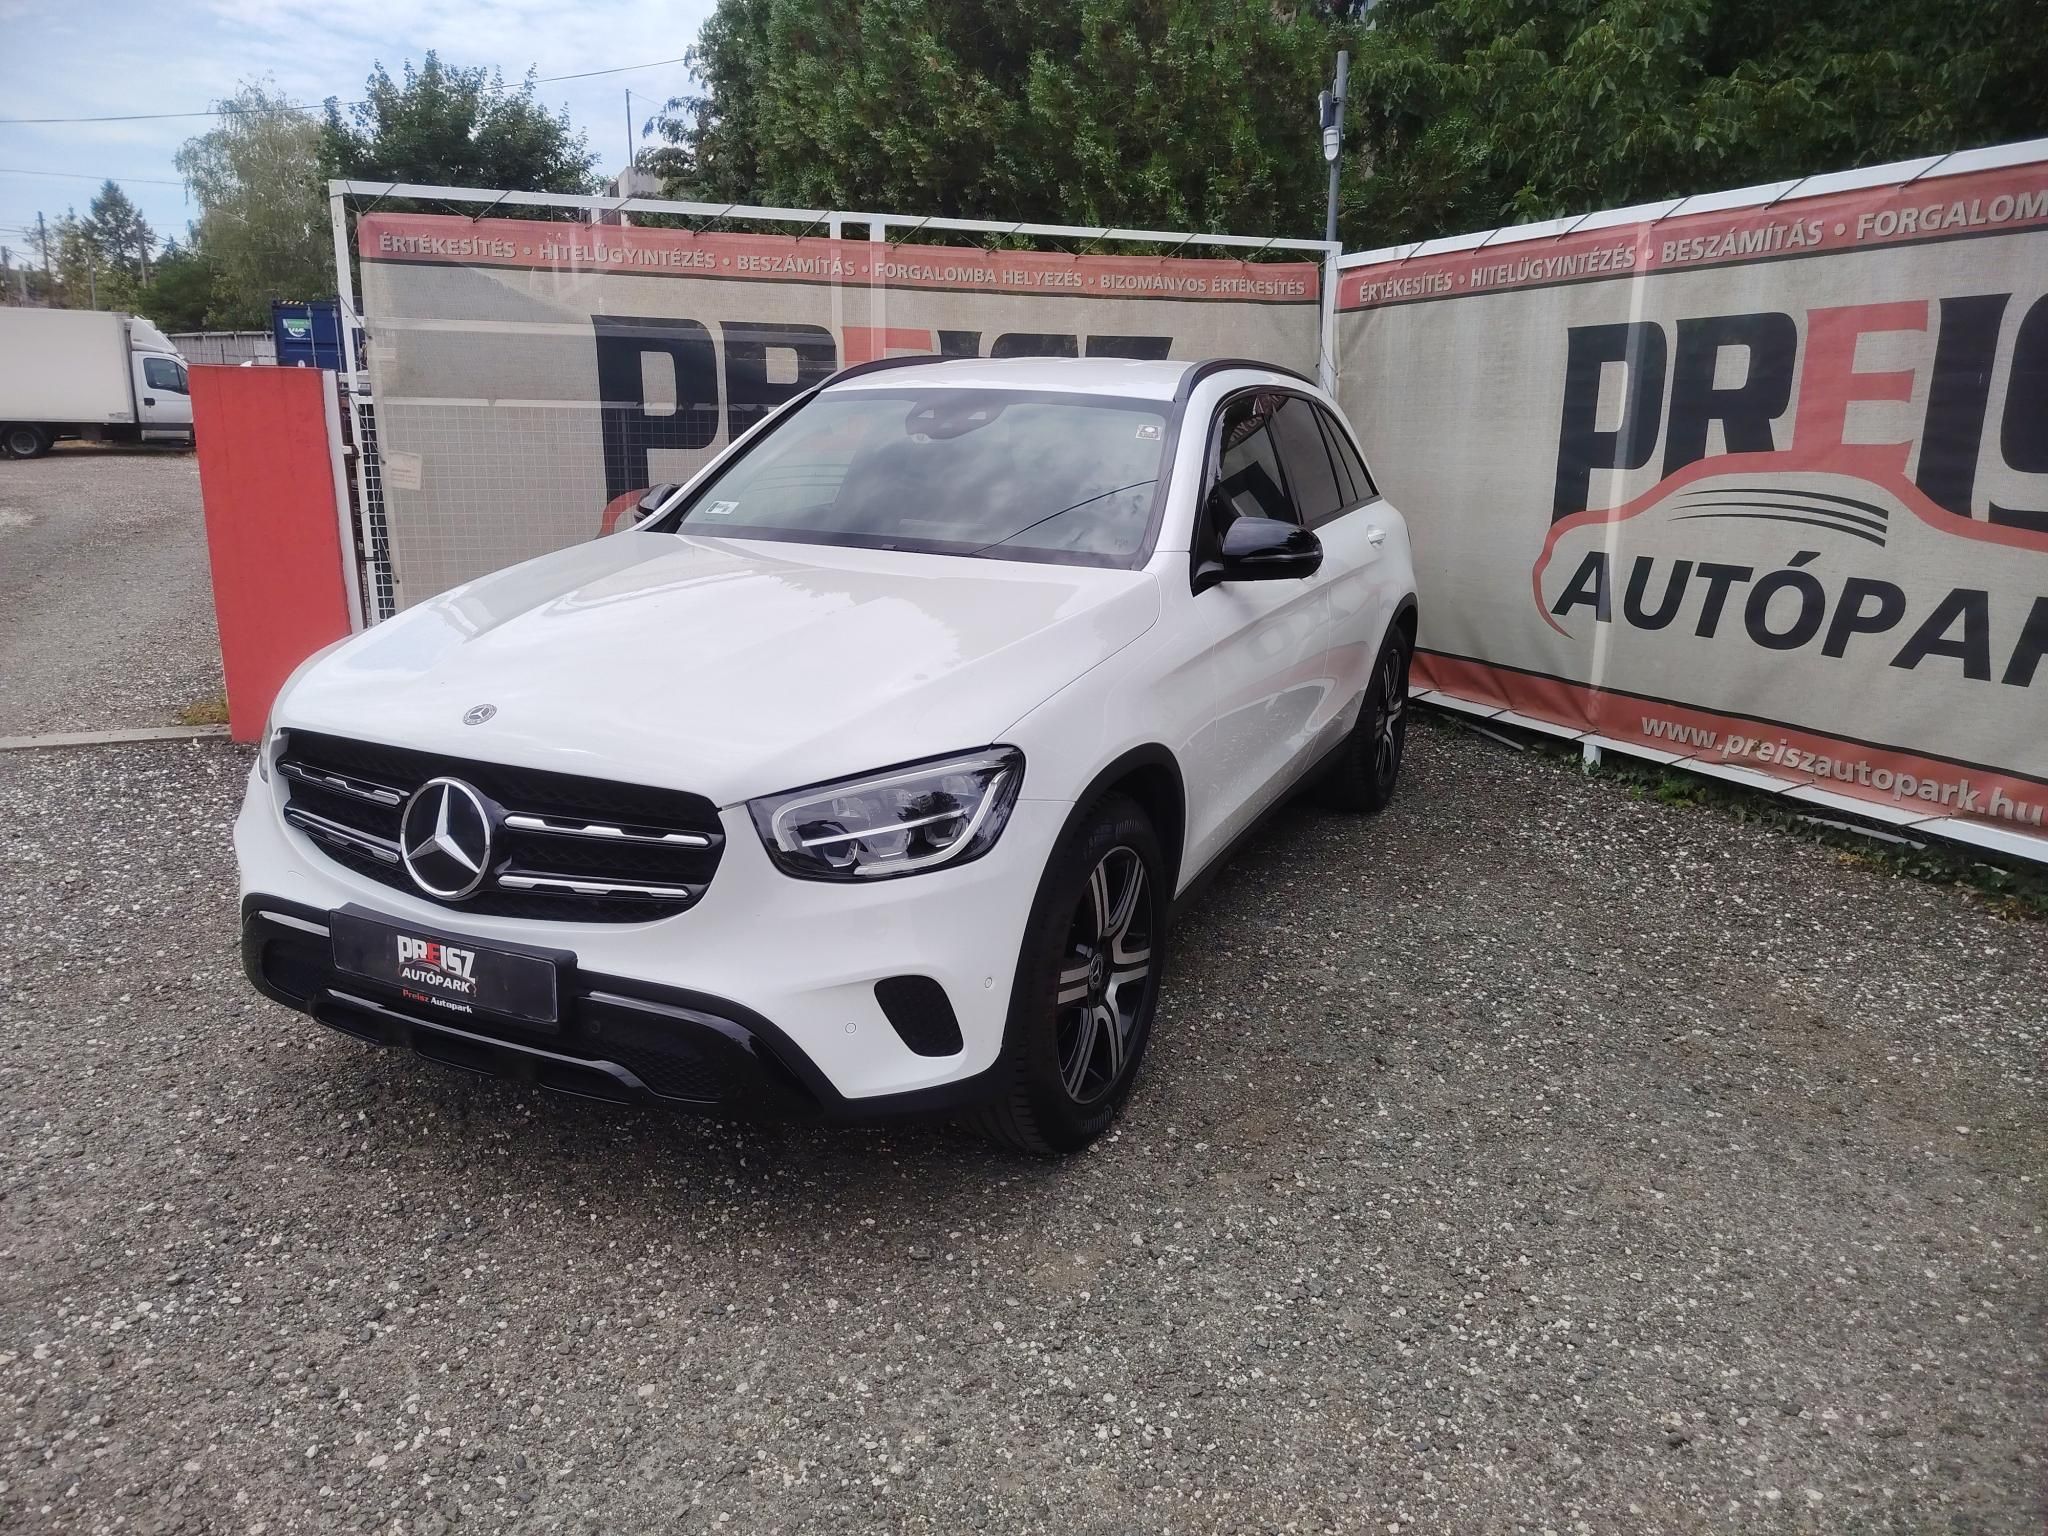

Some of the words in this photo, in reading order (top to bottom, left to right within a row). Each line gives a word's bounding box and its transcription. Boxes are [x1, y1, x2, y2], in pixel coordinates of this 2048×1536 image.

[379, 232, 517, 259] ÉRTÉKESÍTÉS
[539, 243, 717, 269] HITELÜGYINTÉZÉS
[737, 254, 856, 277] BESZÁMÍTÁS
[874, 262, 998, 285] FORGALOMBA
[1002, 269, 1083, 289] HELYEZÉS
[1100, 273, 1207, 294] BIZOMÁNYOS
[1211, 275, 1306, 297] ÉRTÉKESÍTÉS
[1360, 272, 1453, 303] ÉRTÉKESÍTÉS
[1470, 245, 1636, 287] HITELÜGYINTÉZÉS
[1661, 218, 1824, 264] BESZÁMÍTÁS
[1641, 716, 2045, 827] www.preiszautopark.hu
[397, 935, 476, 984] PREISZ
[401, 967, 470, 993] AUTÓPARK
[403, 989, 429, 1002] Preisz
[431, 996, 473, 1014] Autopark
